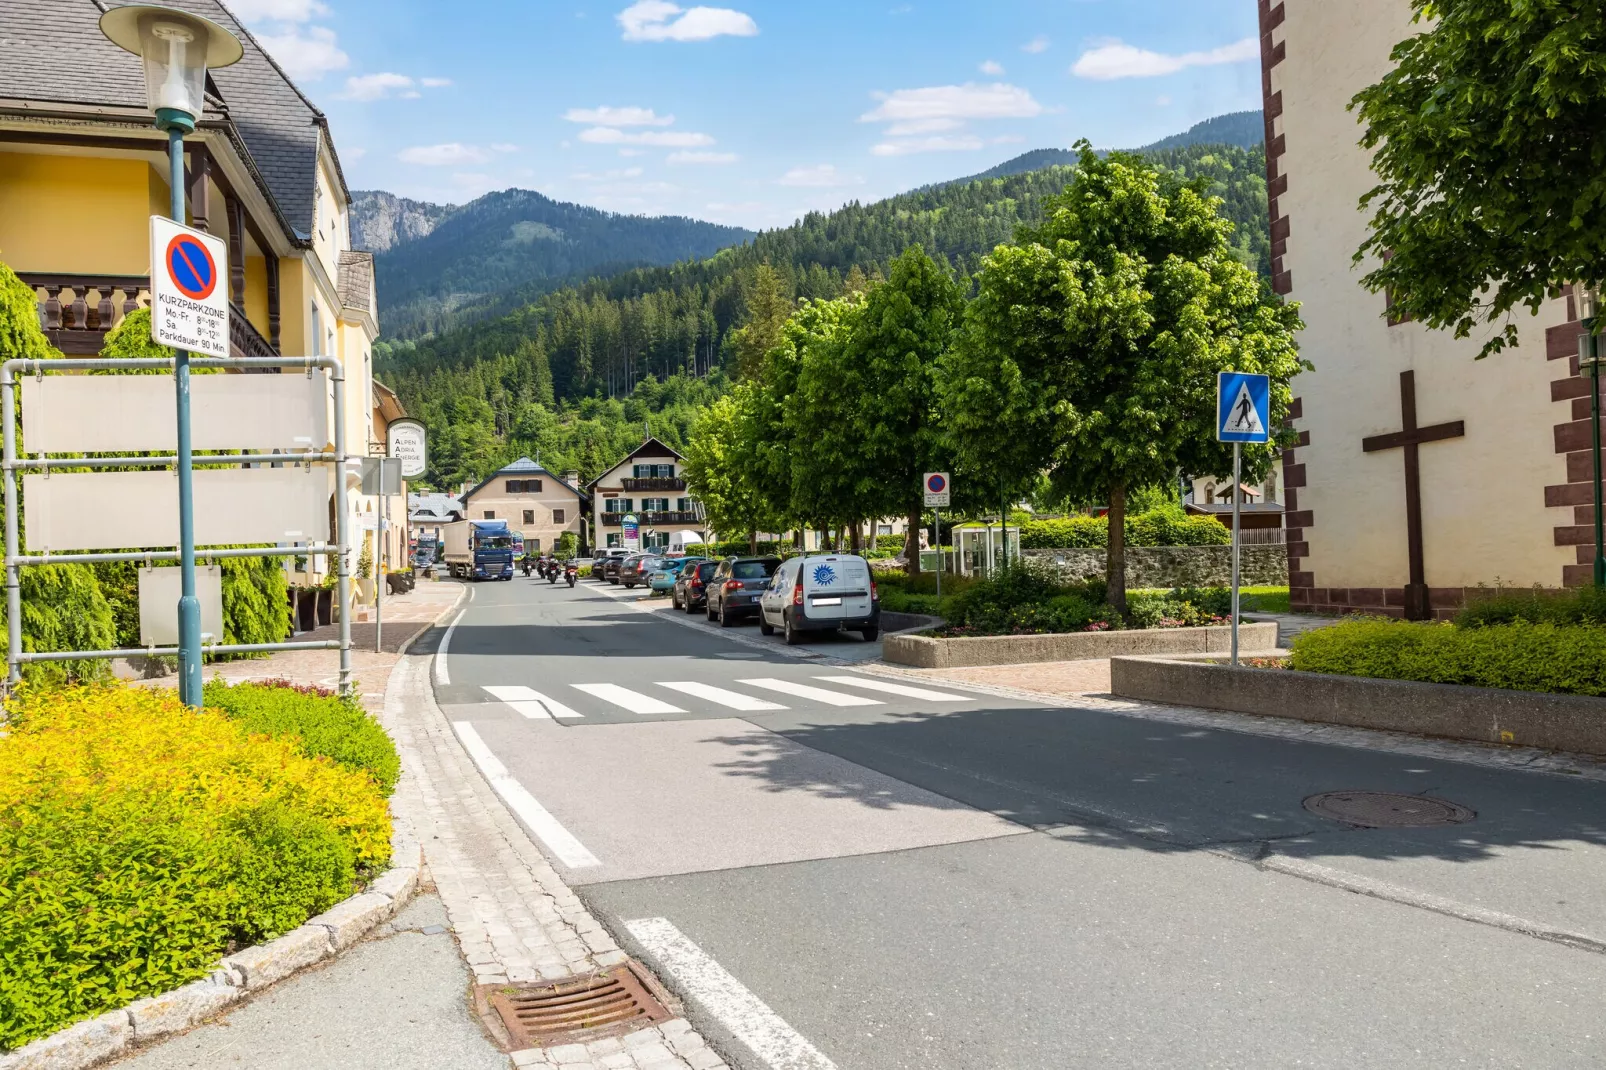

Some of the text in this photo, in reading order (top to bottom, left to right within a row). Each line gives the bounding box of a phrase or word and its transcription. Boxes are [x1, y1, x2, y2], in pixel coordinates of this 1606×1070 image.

[159, 293, 225, 319] KURZPARKZONE
[160, 329, 198, 346] Parkdauer
[202, 340, 210, 349] 90
